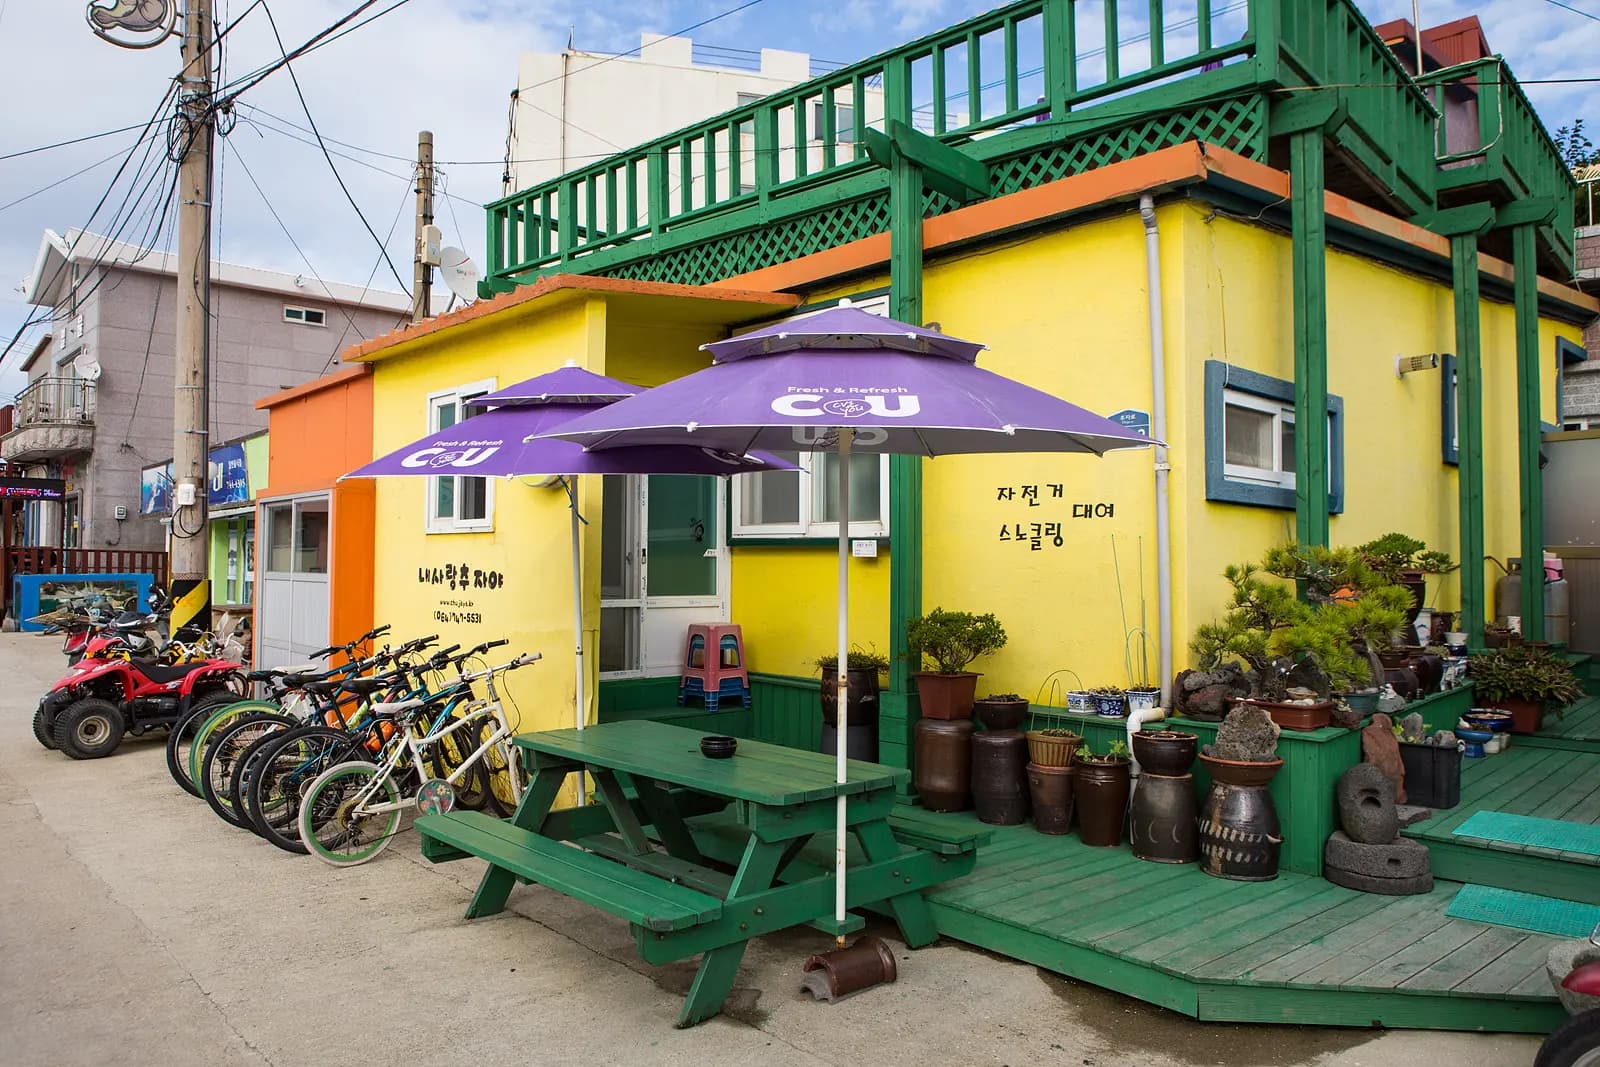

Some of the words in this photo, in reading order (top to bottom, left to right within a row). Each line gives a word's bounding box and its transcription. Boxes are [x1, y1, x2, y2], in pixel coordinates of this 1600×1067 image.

[849, 386, 908, 394] Refresh
[771, 394, 920, 418] CU
[401, 447, 501, 468] CU
[997, 484, 1063, 507] 자전거
[1072, 503, 1114, 518] 대여
[999, 522, 1064, 551] 스노클링
